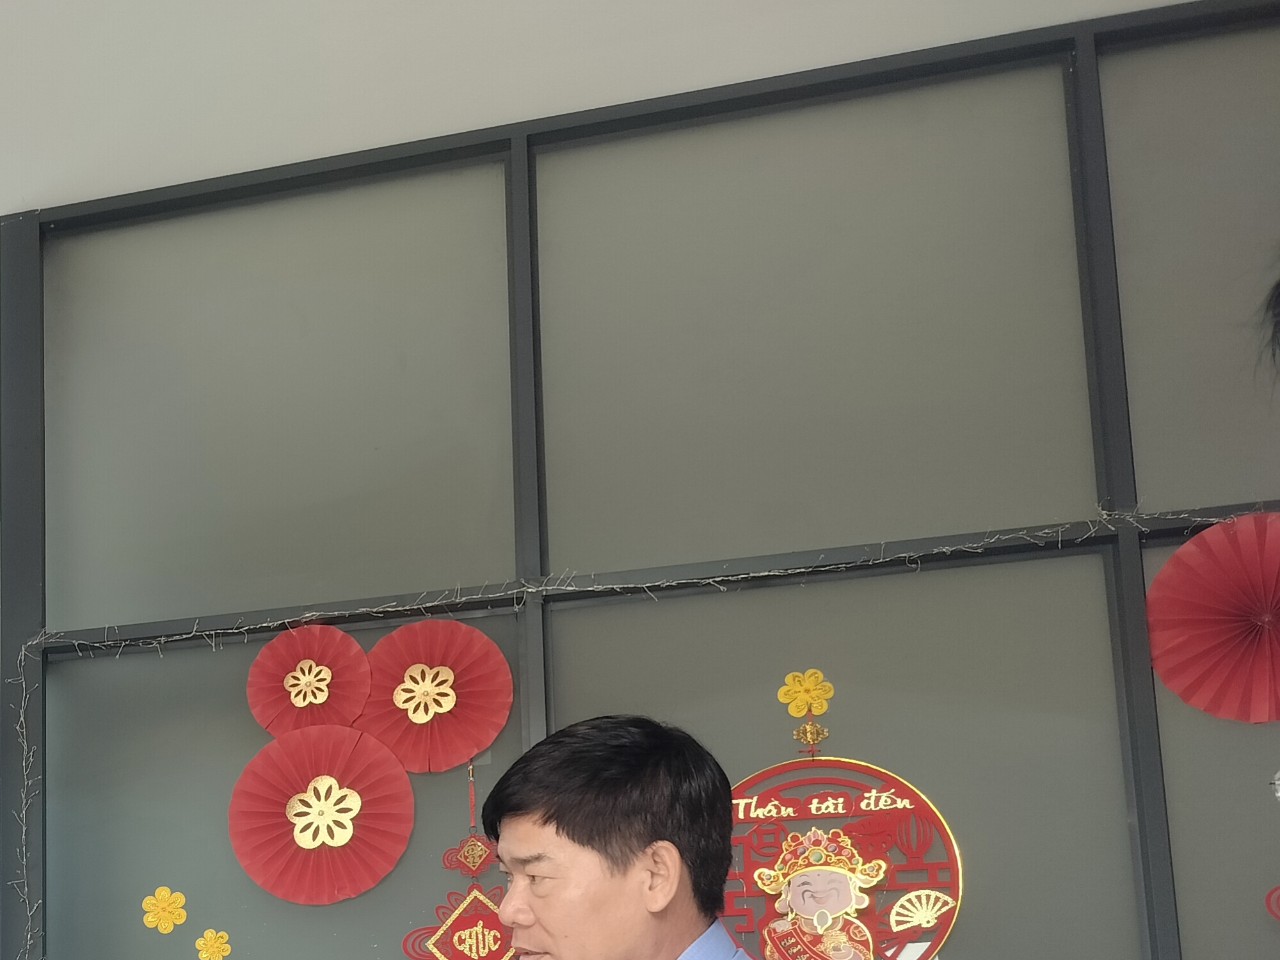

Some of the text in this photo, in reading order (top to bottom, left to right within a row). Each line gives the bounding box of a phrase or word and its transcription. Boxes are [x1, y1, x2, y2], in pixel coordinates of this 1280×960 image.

[808, 797, 846, 815] tài
[860, 789, 915, 811] đến
[453, 920, 501, 960] CHÚC
